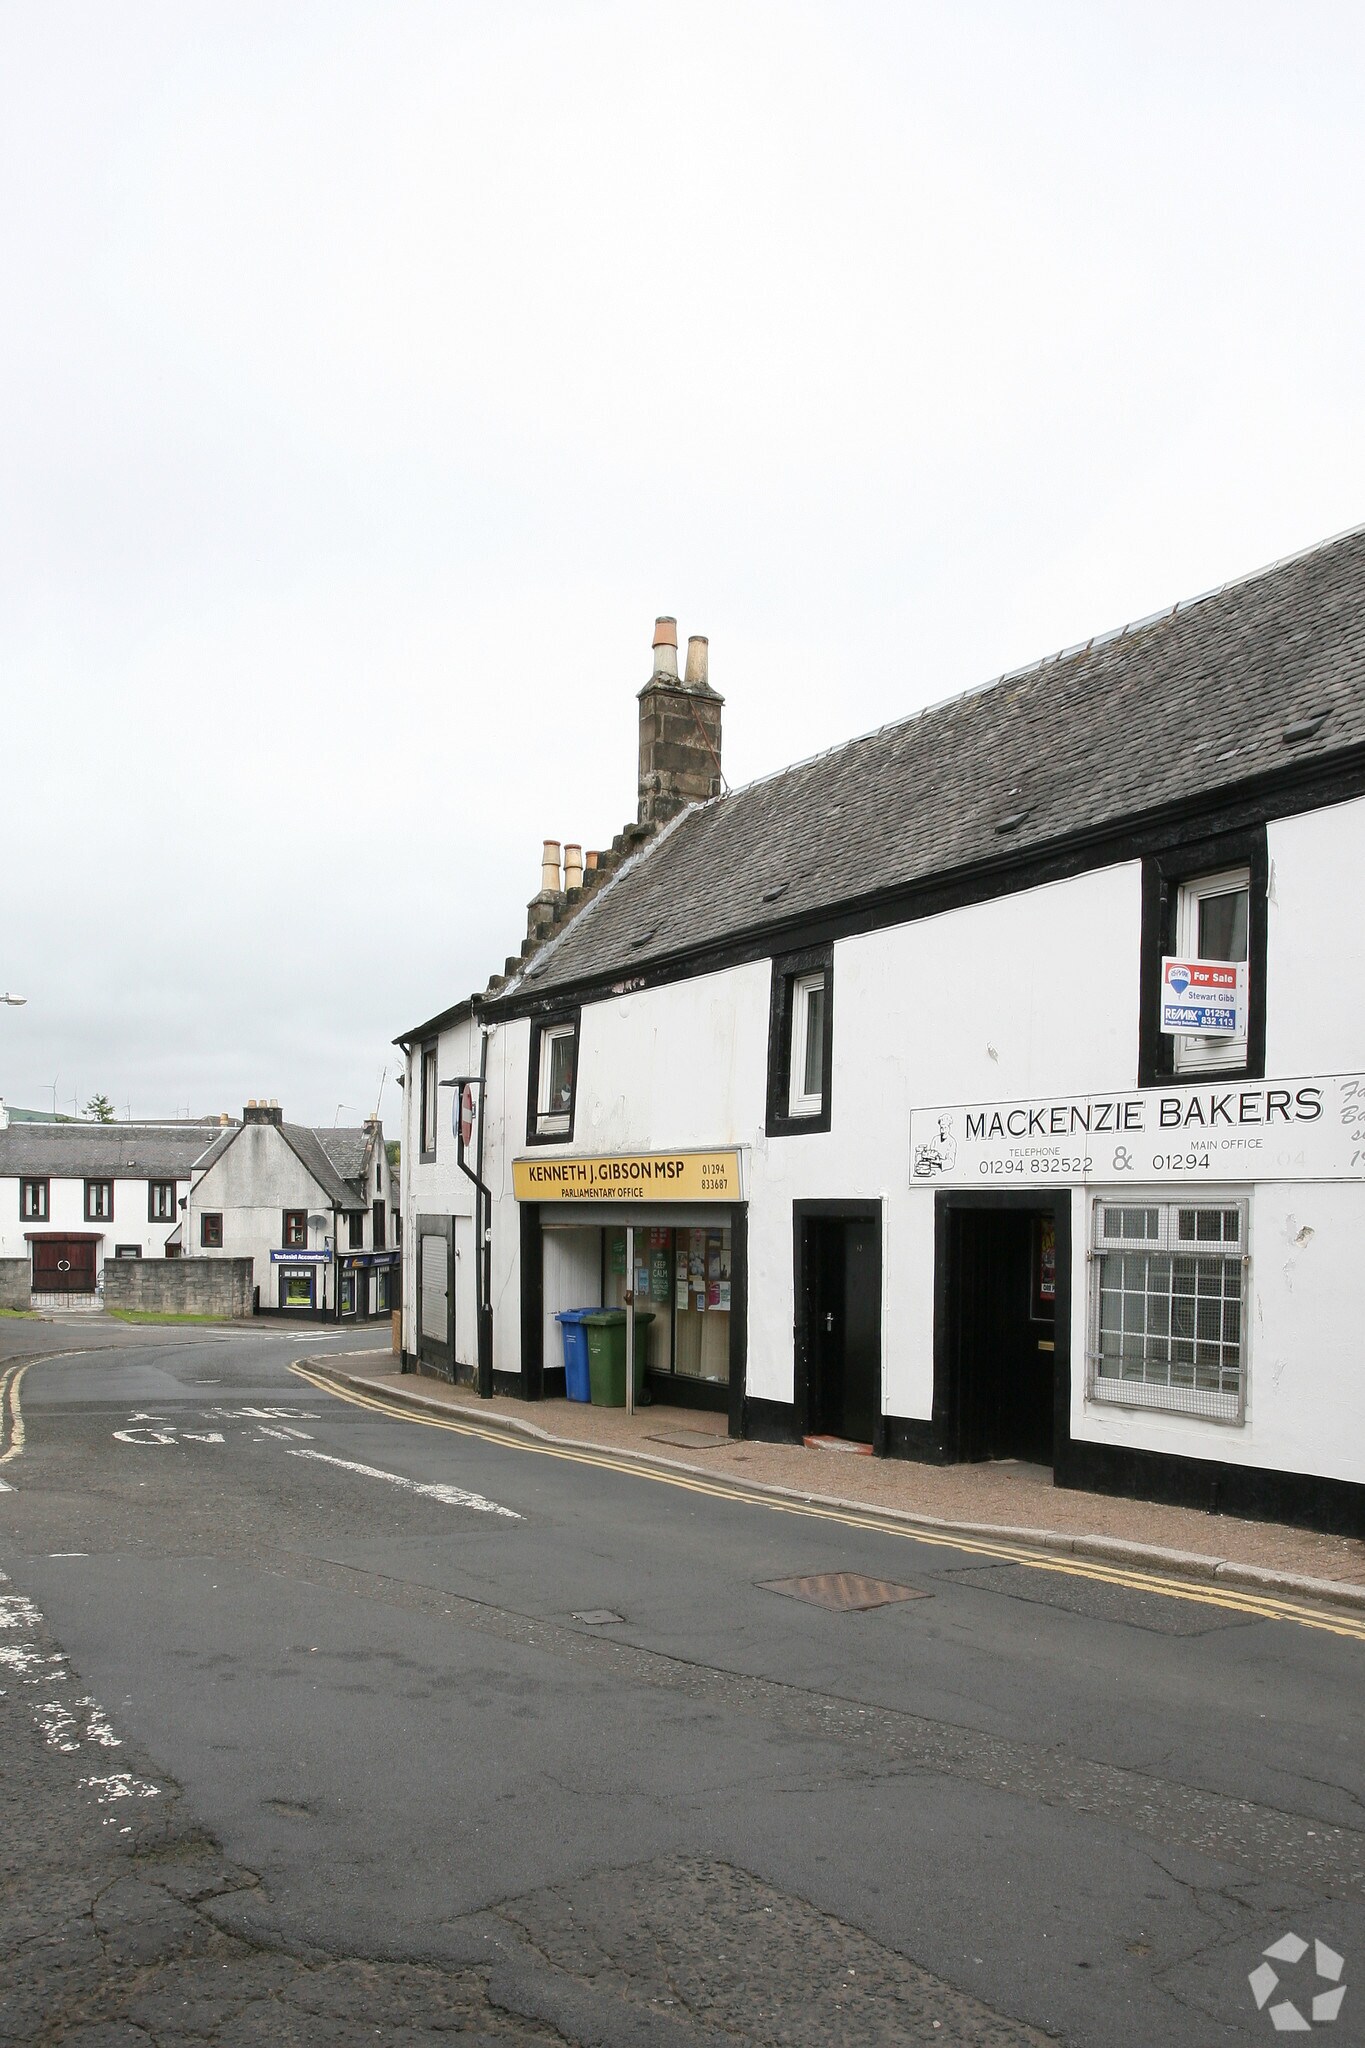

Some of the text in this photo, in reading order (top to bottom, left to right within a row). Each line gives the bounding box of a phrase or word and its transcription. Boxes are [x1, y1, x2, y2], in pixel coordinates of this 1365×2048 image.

[1194, 971, 1210, 980] For
[1213, 973, 1233, 983] Sale
[1189, 991, 1234, 1002] Stewart Gibb
[1204, 1009, 1230, 1018] 01294
[1201, 1016, 1234, 1026] 832 113
[965, 1086, 1325, 1141] MACKENZIE BAKERS
[1190, 1138, 1264, 1150] MAIN OFFICE
[1009, 1146, 1061, 1157] TELEPHONE
[978, 1159, 1025, 1174] 01294
[1030, 1157, 1093, 1174] 832522
[1112, 1145, 1133, 1171] &
[1152, 1153, 1210, 1170] 01294
[529, 1161, 684, 1184] KENNETH J. GIBSON MSP
[702, 1163, 725, 1175] 01294
[701, 1179, 728, 1190] 833687
[561, 1186, 644, 1198] PARLIAMENTARY OFFICE
[652, 1269, 668, 1278] CALM
